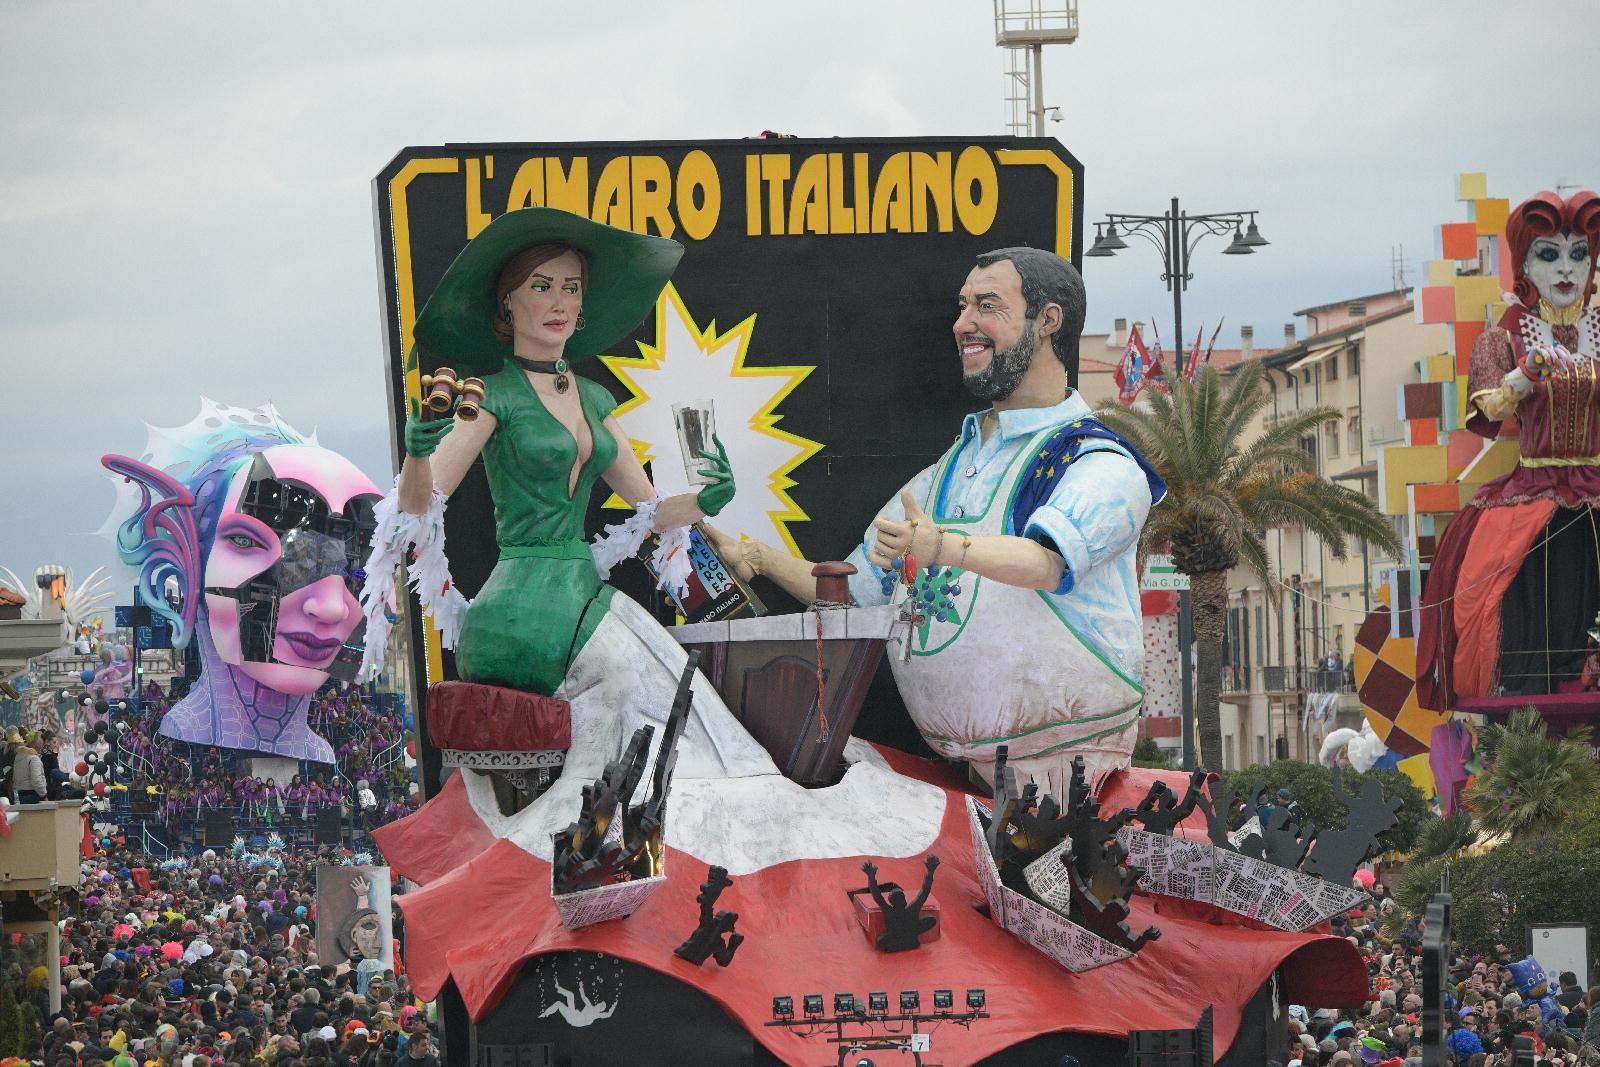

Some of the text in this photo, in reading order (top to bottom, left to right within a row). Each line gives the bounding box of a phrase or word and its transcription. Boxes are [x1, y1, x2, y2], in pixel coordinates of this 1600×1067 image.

[465, 146, 998, 240] L'AMARO ITALIANO
[687, 548, 722, 594] MARE
[694, 537, 734, 592] NEGRO
[917, 1042, 923, 1050] 7
